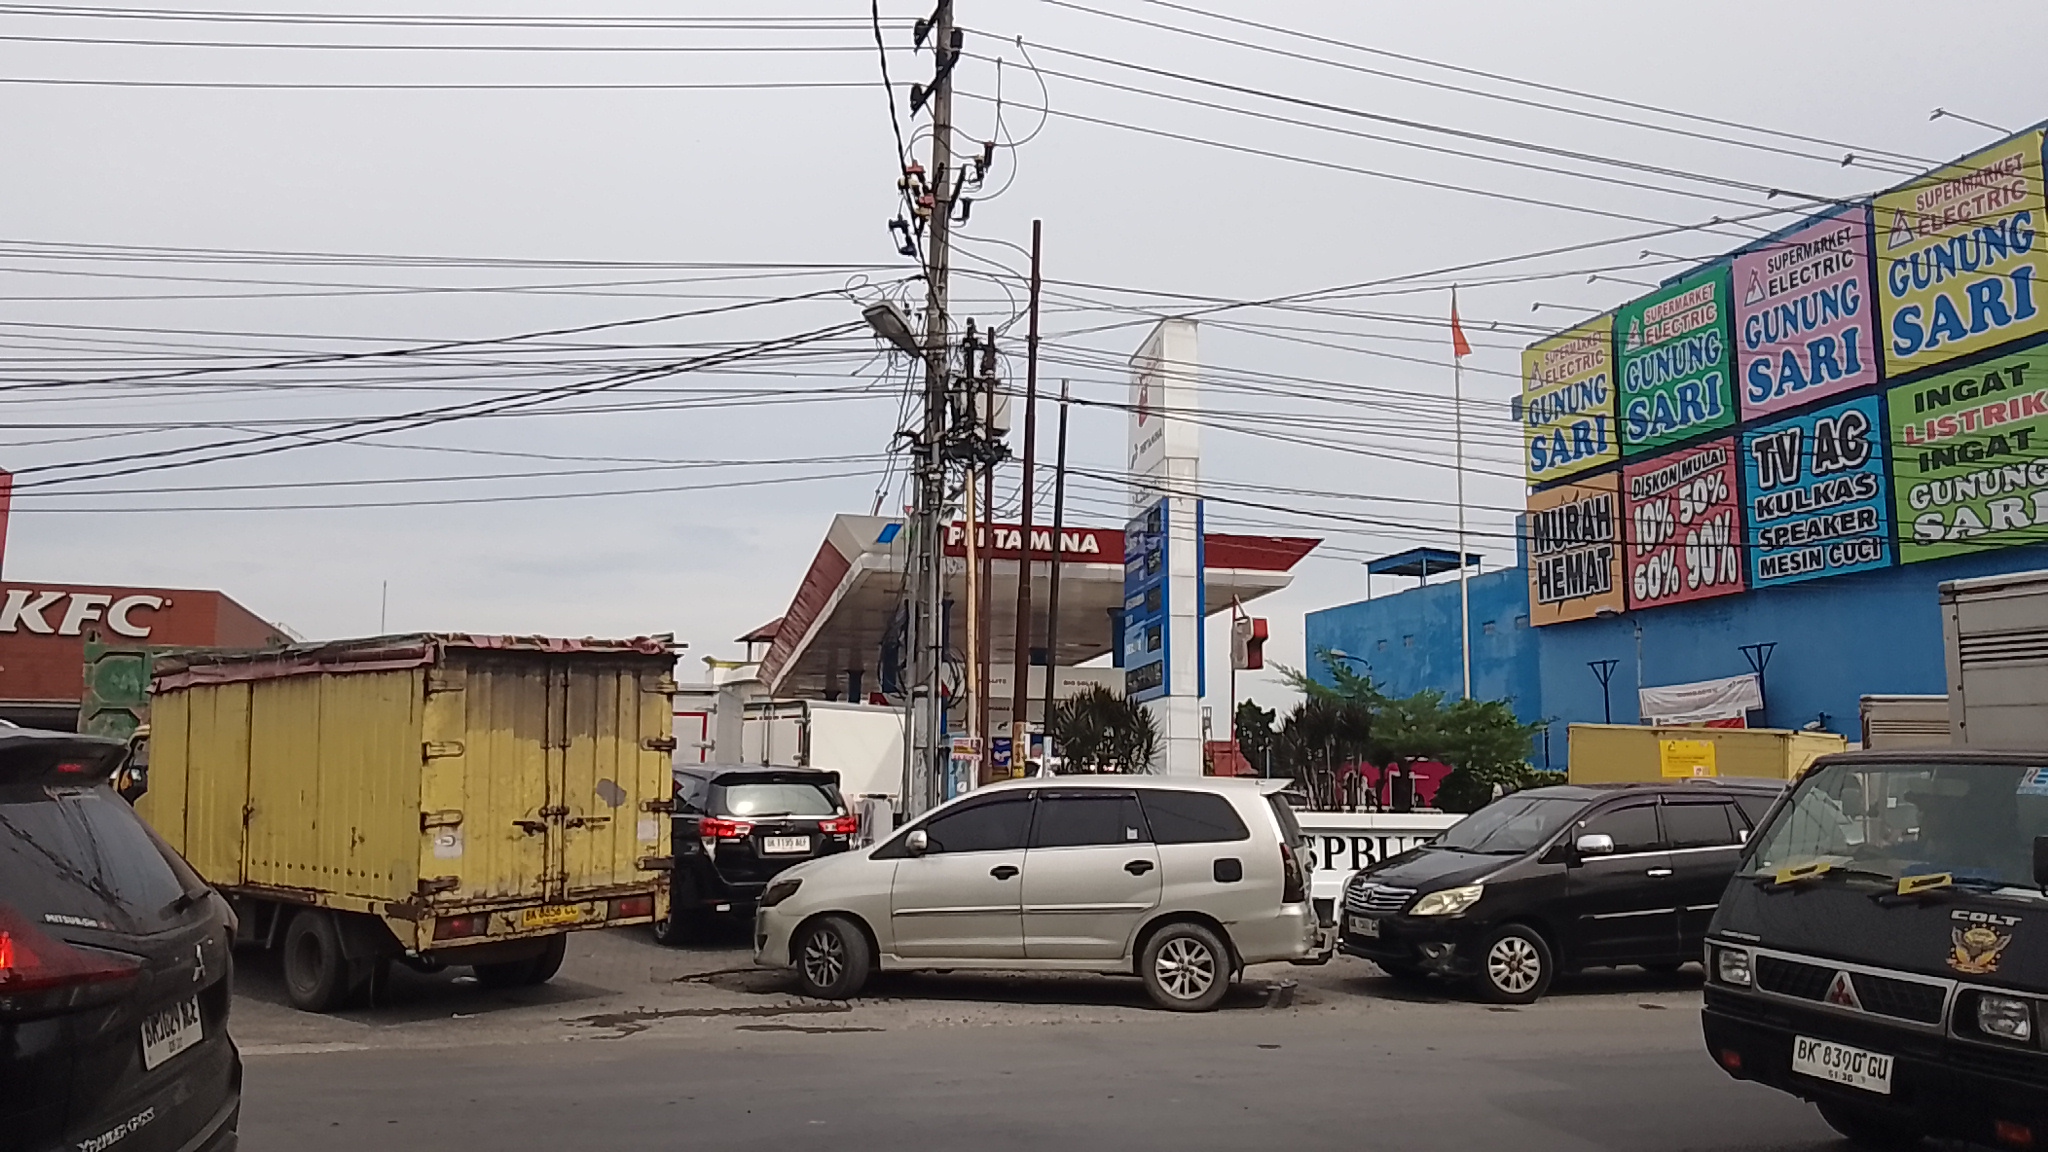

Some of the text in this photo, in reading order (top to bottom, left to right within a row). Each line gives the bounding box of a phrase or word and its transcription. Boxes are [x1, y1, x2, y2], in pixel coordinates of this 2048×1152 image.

[1916, 152, 2024, 212] SUPERMARKET
[1918, 179, 2027, 237] ELECTRIC
[1767, 226, 1852, 274] SUPERMARKET
[1768, 251, 1854, 298] ELECTRIC
[1889, 210, 2036, 297] GUNUNG
[1643, 281, 1716, 324] SUPERMARKET
[1645, 303, 1717, 346] ELECTRIC
[1744, 278, 1861, 350] GUNUNG
[1893, 265, 2036, 357] SARI
[1544, 331, 1604, 366] SUPERMARKET
[1545, 350, 1604, 385] ELECTRIC
[1625, 329, 1722, 393] GUNUNG
[1747, 326, 1862, 403] SARI
[1528, 373, 1608, 429] GUNUNG
[1628, 373, 1723, 441] SARI
[1914, 362, 2030, 414] INGAT
[1530, 413, 1608, 472] SARI
[1904, 390, 2048, 445] LISTRIK
[1631, 447, 1727, 501] DISKON MULAI
[1752, 410, 1868, 488] TV AC
[1919, 426, 2036, 473] INGAT
[1755, 473, 1877, 522] KULKAS
[1909, 457, 2048, 510] GUNUNG
[1533, 491, 1613, 554] MURAH
[1633, 470, 1728, 556] 10% 50%
[1759, 506, 1877, 551] SPEAKER
[1536, 543, 1613, 604] HEMAT
[1633, 509, 1737, 601] 60% 90%
[1759, 536, 1881, 579] MESIN CUCI
[0, 589, 164, 638] KFC
[1950, 910, 2023, 926] COLT
[1797, 1039, 1889, 1081] BK 8390 GU
